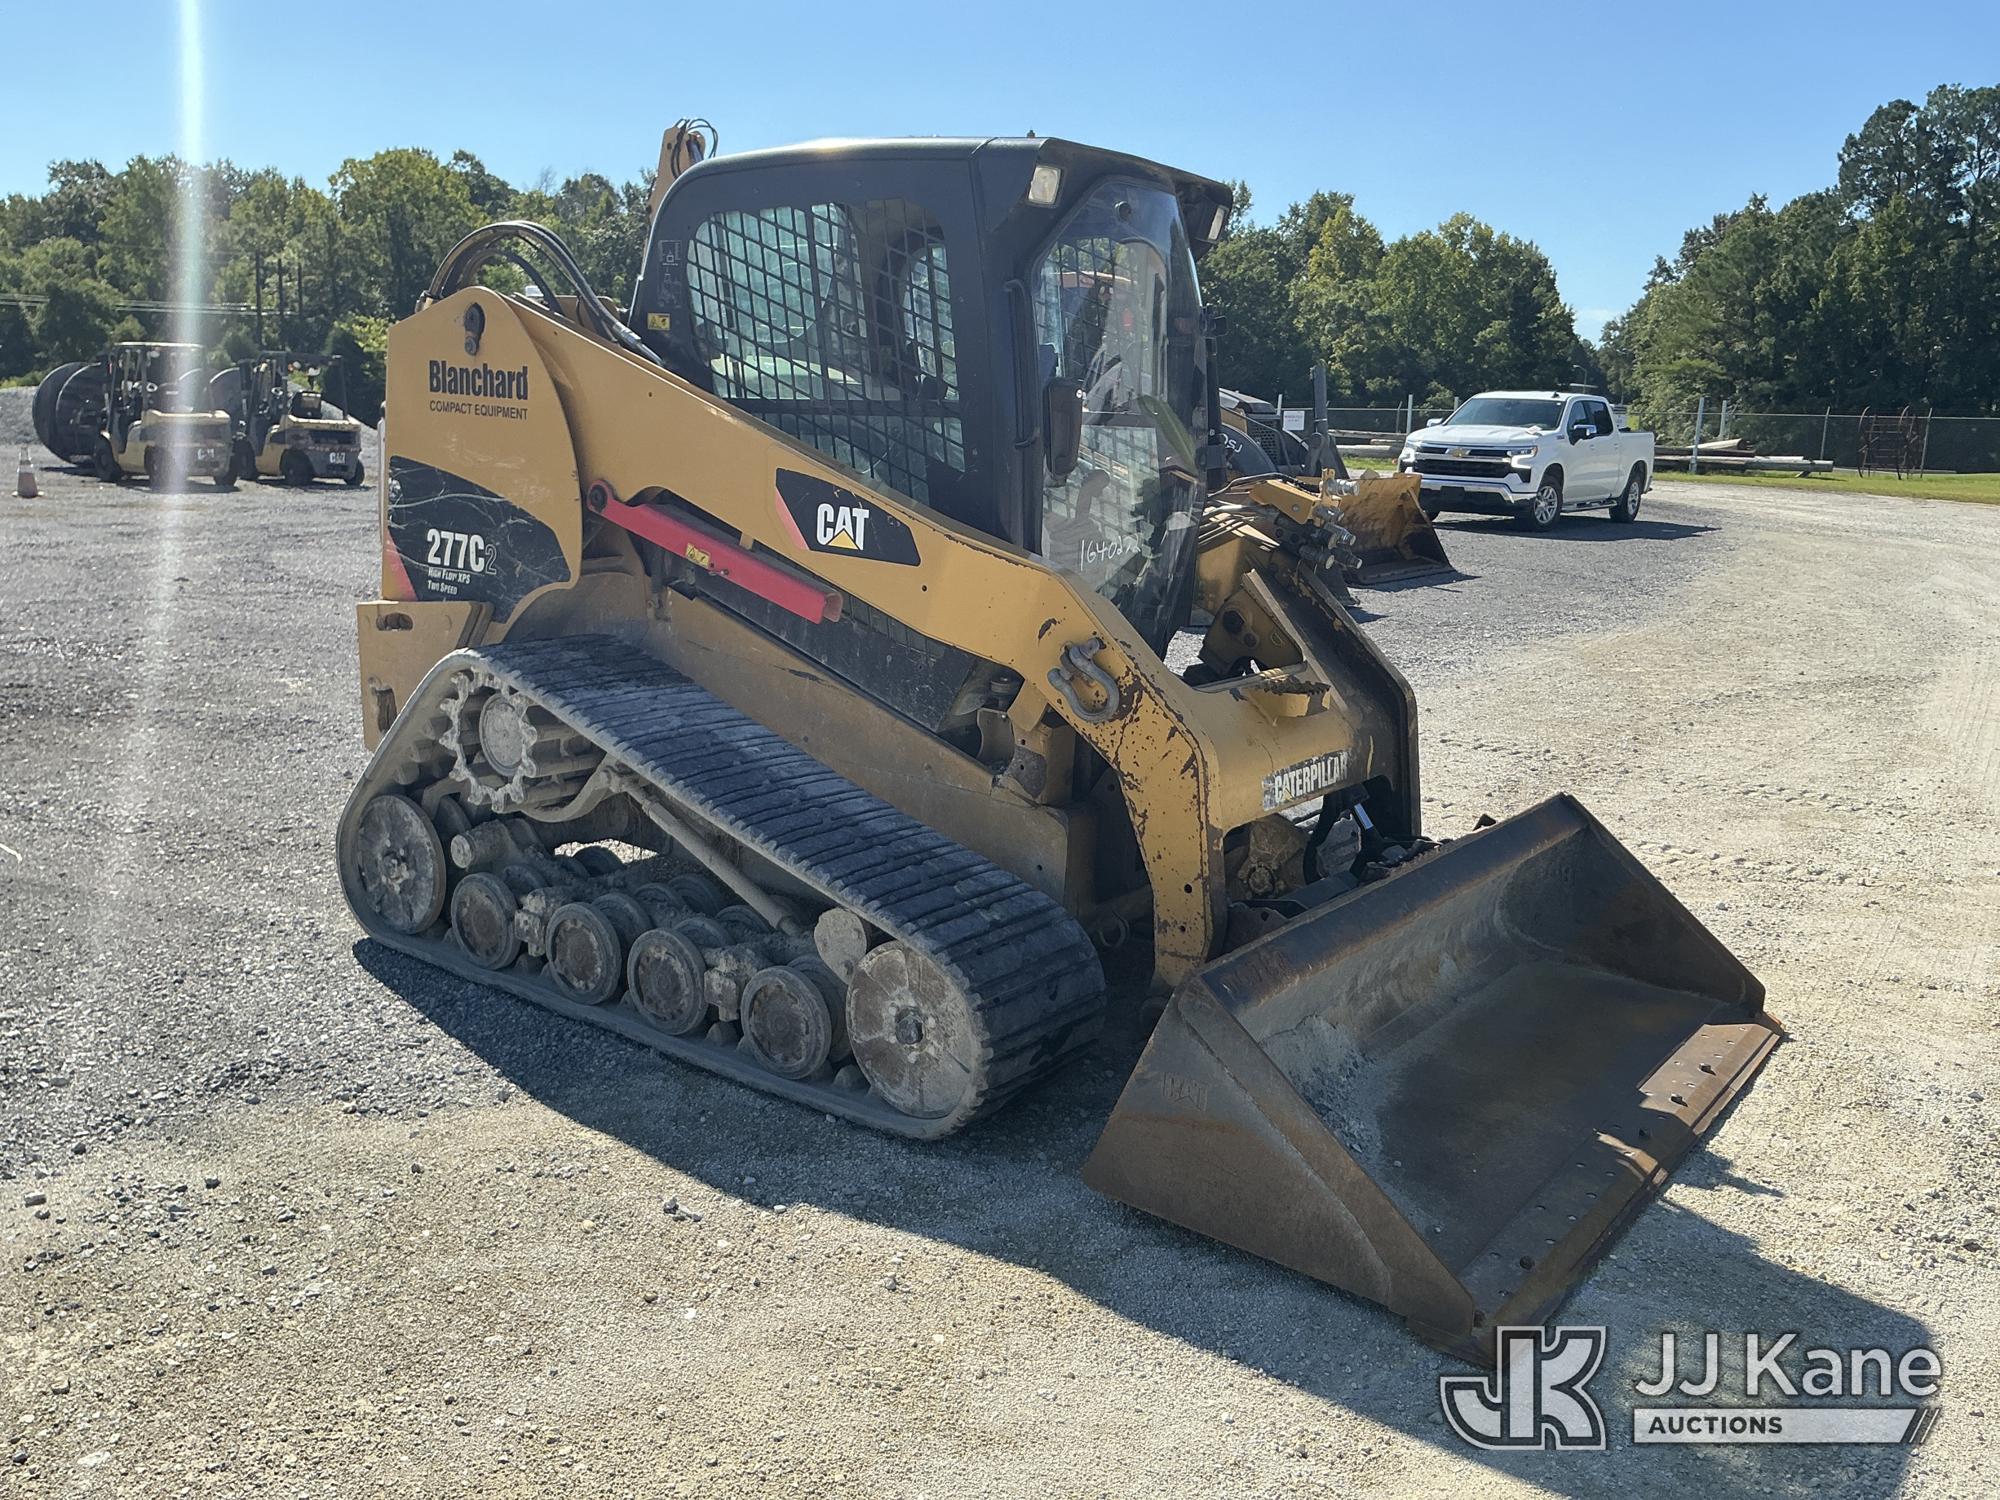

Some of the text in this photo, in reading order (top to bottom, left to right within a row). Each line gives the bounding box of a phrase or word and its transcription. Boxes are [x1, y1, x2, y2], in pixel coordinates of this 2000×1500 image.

[429, 359, 528, 400] Blanchard
[429, 400, 528, 421] COMPACT EQUIPMENT
[816, 503, 870, 551] CAT
[458, 572, 471, 585] XPS
[1274, 751, 1348, 804] CATERPILLAR
